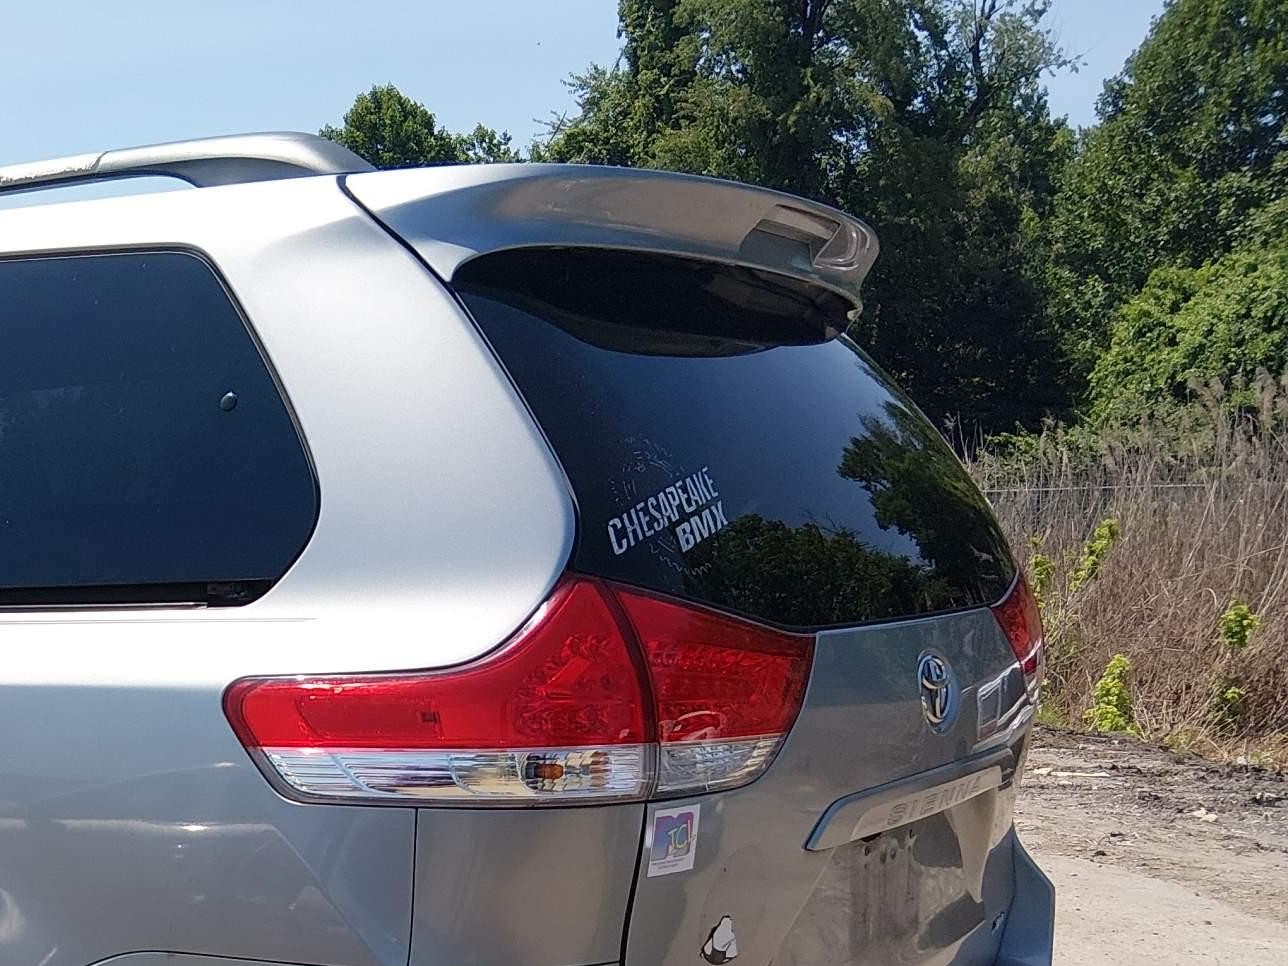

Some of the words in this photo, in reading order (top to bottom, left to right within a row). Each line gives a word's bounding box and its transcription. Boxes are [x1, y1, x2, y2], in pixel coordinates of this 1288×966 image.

[607, 466, 719, 556] CHESAPEAKE
[675, 500, 729, 553] BMX
[887, 775, 981, 826] SIENNA
